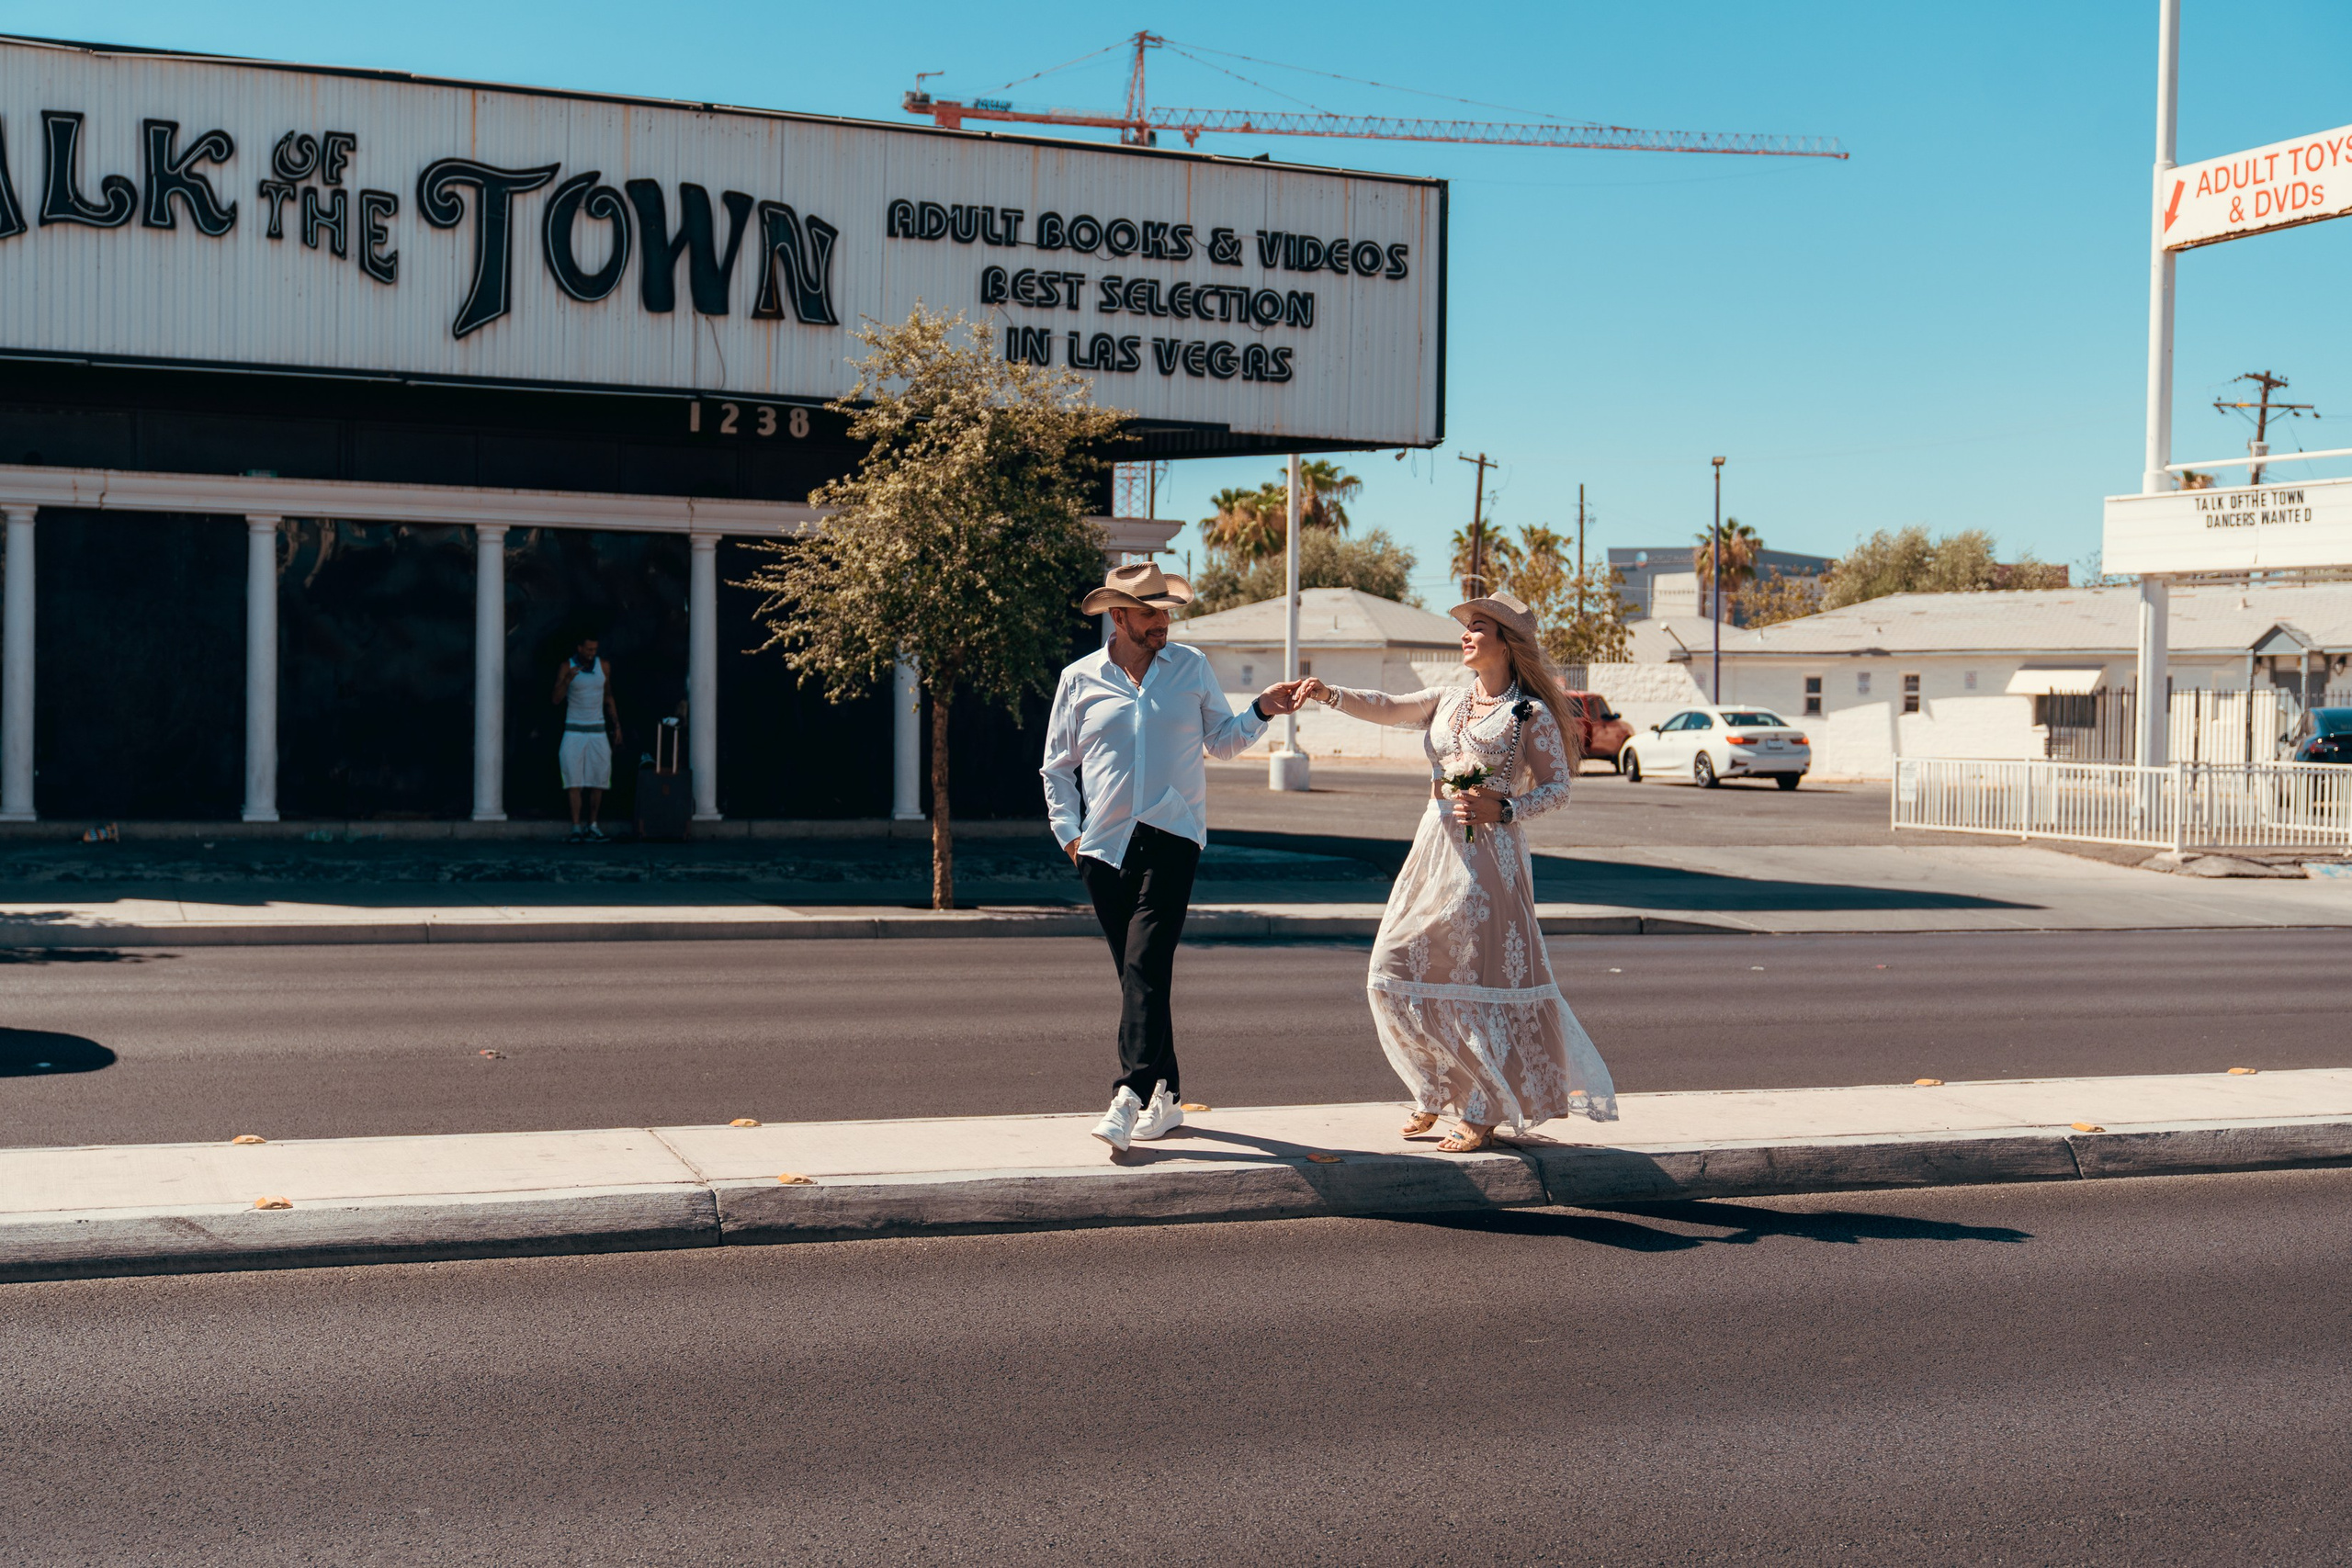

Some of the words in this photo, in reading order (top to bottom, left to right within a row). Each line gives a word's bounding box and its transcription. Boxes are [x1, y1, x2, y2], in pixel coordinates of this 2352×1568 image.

[272, 130, 357, 185] OF
[2197, 152, 2279, 198] ADULT
[2228, 195, 2245, 224] &
[2254, 181, 2324, 219] DVDs
[258, 179, 400, 287] THE
[416, 158, 841, 341] TOWN
[887, 197, 1024, 247] ADULT
[1036, 210, 1193, 261] BOOKS
[1206, 227, 1243, 266] &
[1256, 229, 1409, 281] VIDEOS
[979, 265, 1086, 310] BEST
[1098, 275, 1315, 330] SELECTION
[1005, 325, 1052, 367] IN
[1067, 331, 1142, 373] LAS
[1151, 336, 1294, 383] VEGAS
[690, 401, 809, 438] 1238
[2195, 497, 2223, 511] TALK
[2270, 490, 2304, 505] TOWN
[2207, 513, 2255, 528] DANCERS
